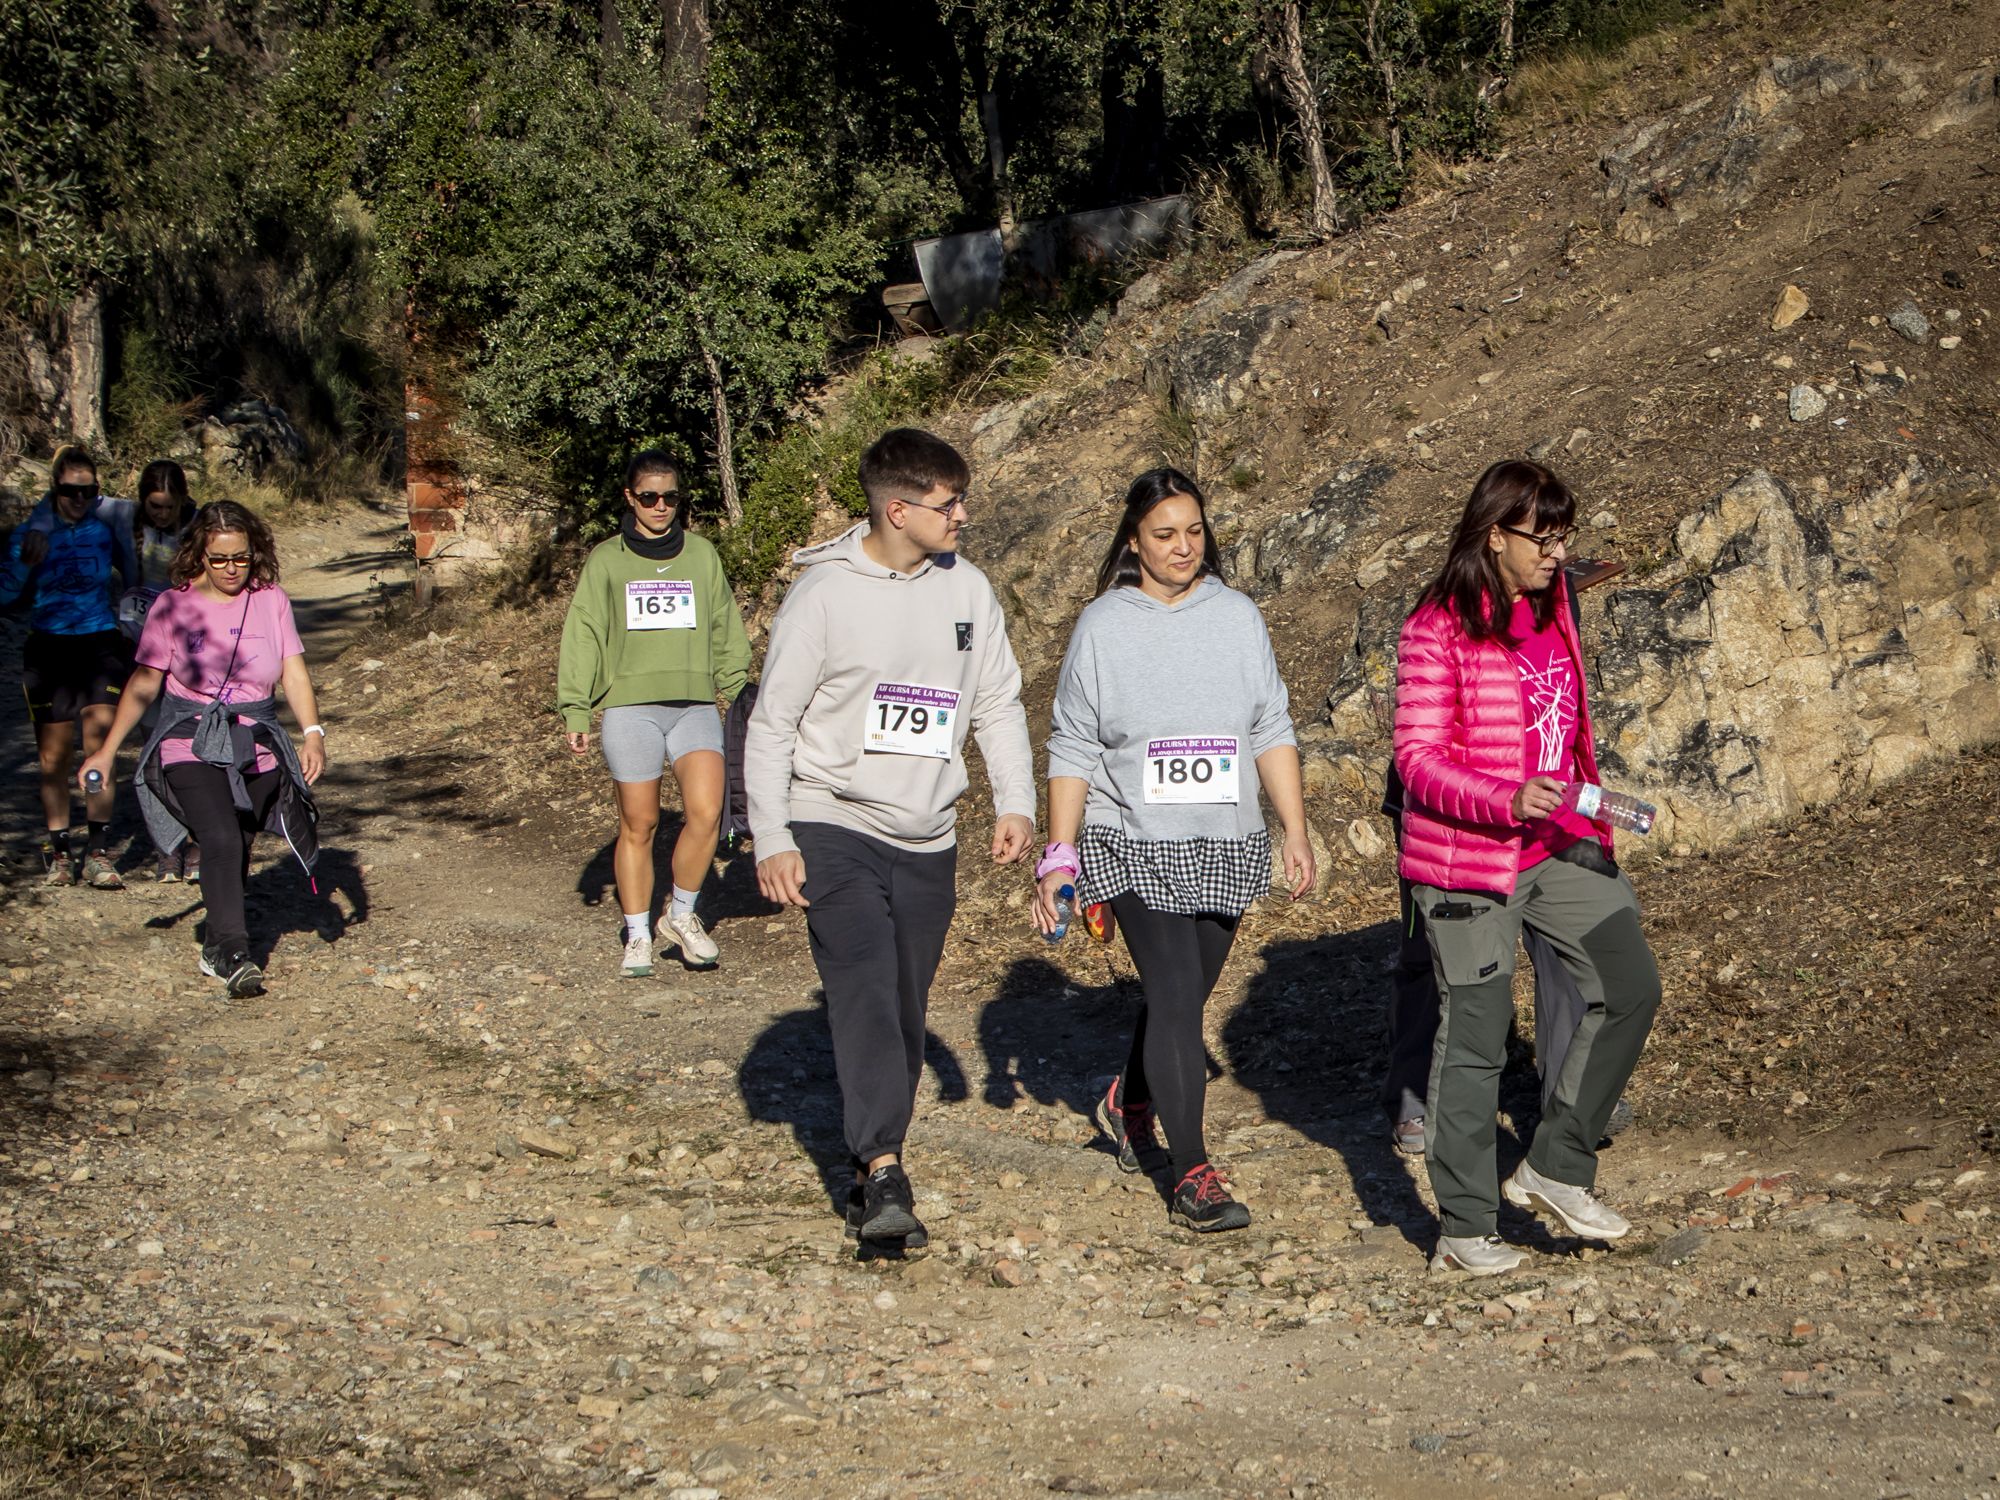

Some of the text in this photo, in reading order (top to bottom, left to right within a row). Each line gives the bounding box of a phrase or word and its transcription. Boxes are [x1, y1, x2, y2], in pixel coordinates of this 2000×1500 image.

[635, 596, 676, 614] 163
[888, 686, 910, 694] CURSA
[935, 690, 957, 700] DONA
[879, 704, 928, 734] 179
[1153, 758, 1213, 784] 180
